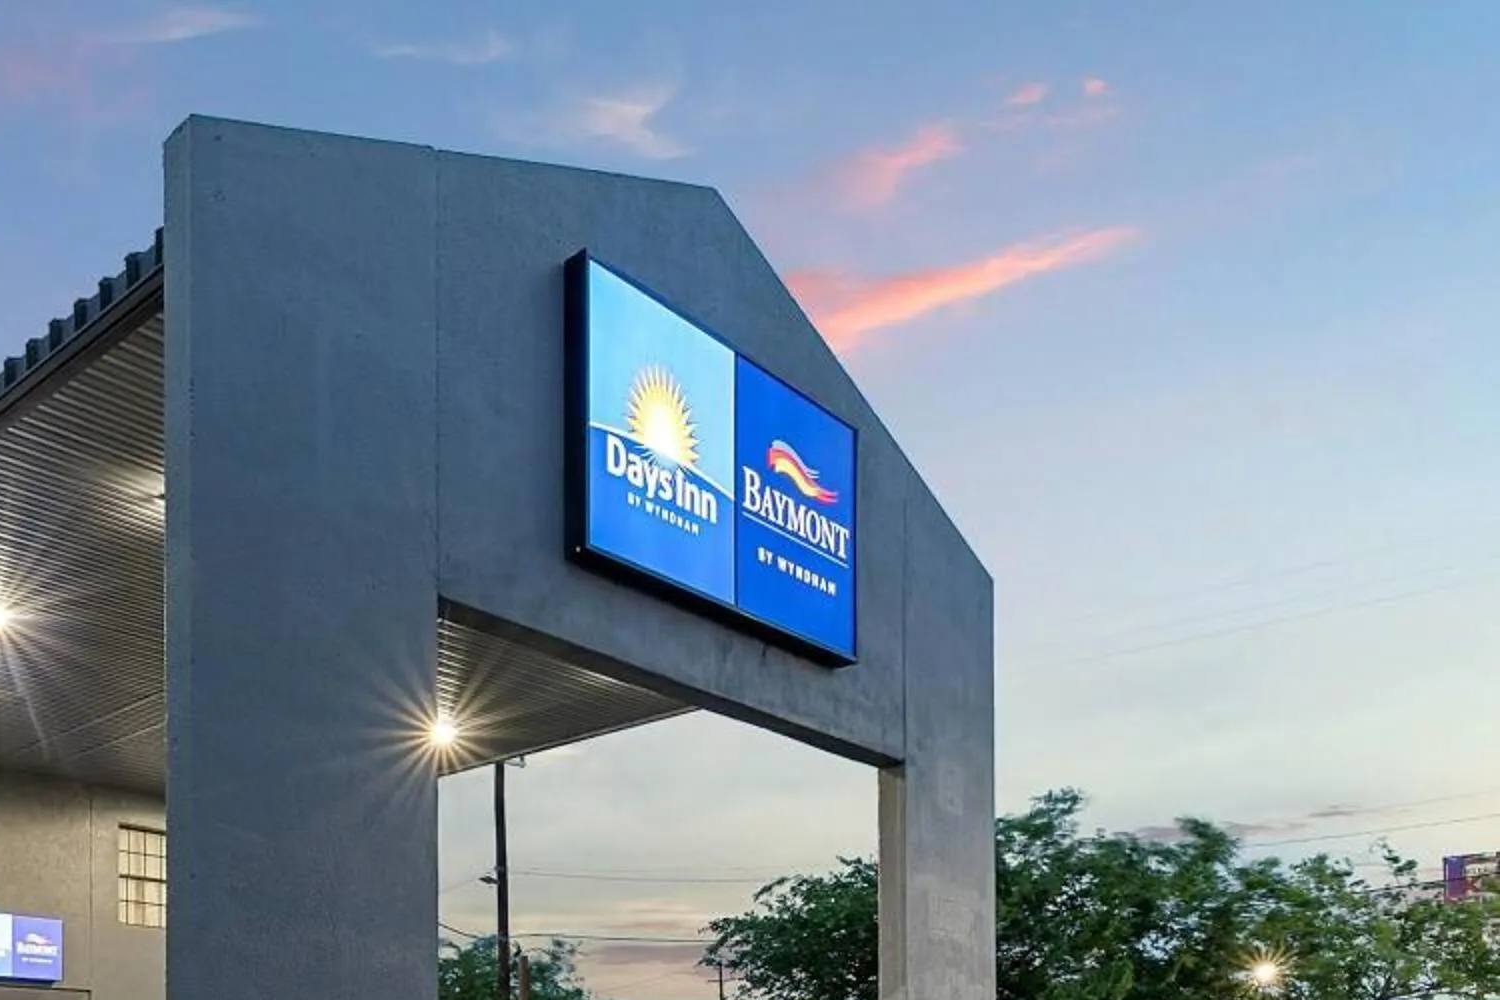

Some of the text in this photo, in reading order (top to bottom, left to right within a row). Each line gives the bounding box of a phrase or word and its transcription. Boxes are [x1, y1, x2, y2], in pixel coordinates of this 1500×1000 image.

[607, 433, 717, 524] Days Inn
[742, 465, 850, 559] BAYMONT
[627, 492, 699, 536] BY WYNDHAM
[757, 547, 837, 596] BY WYNDHAM
